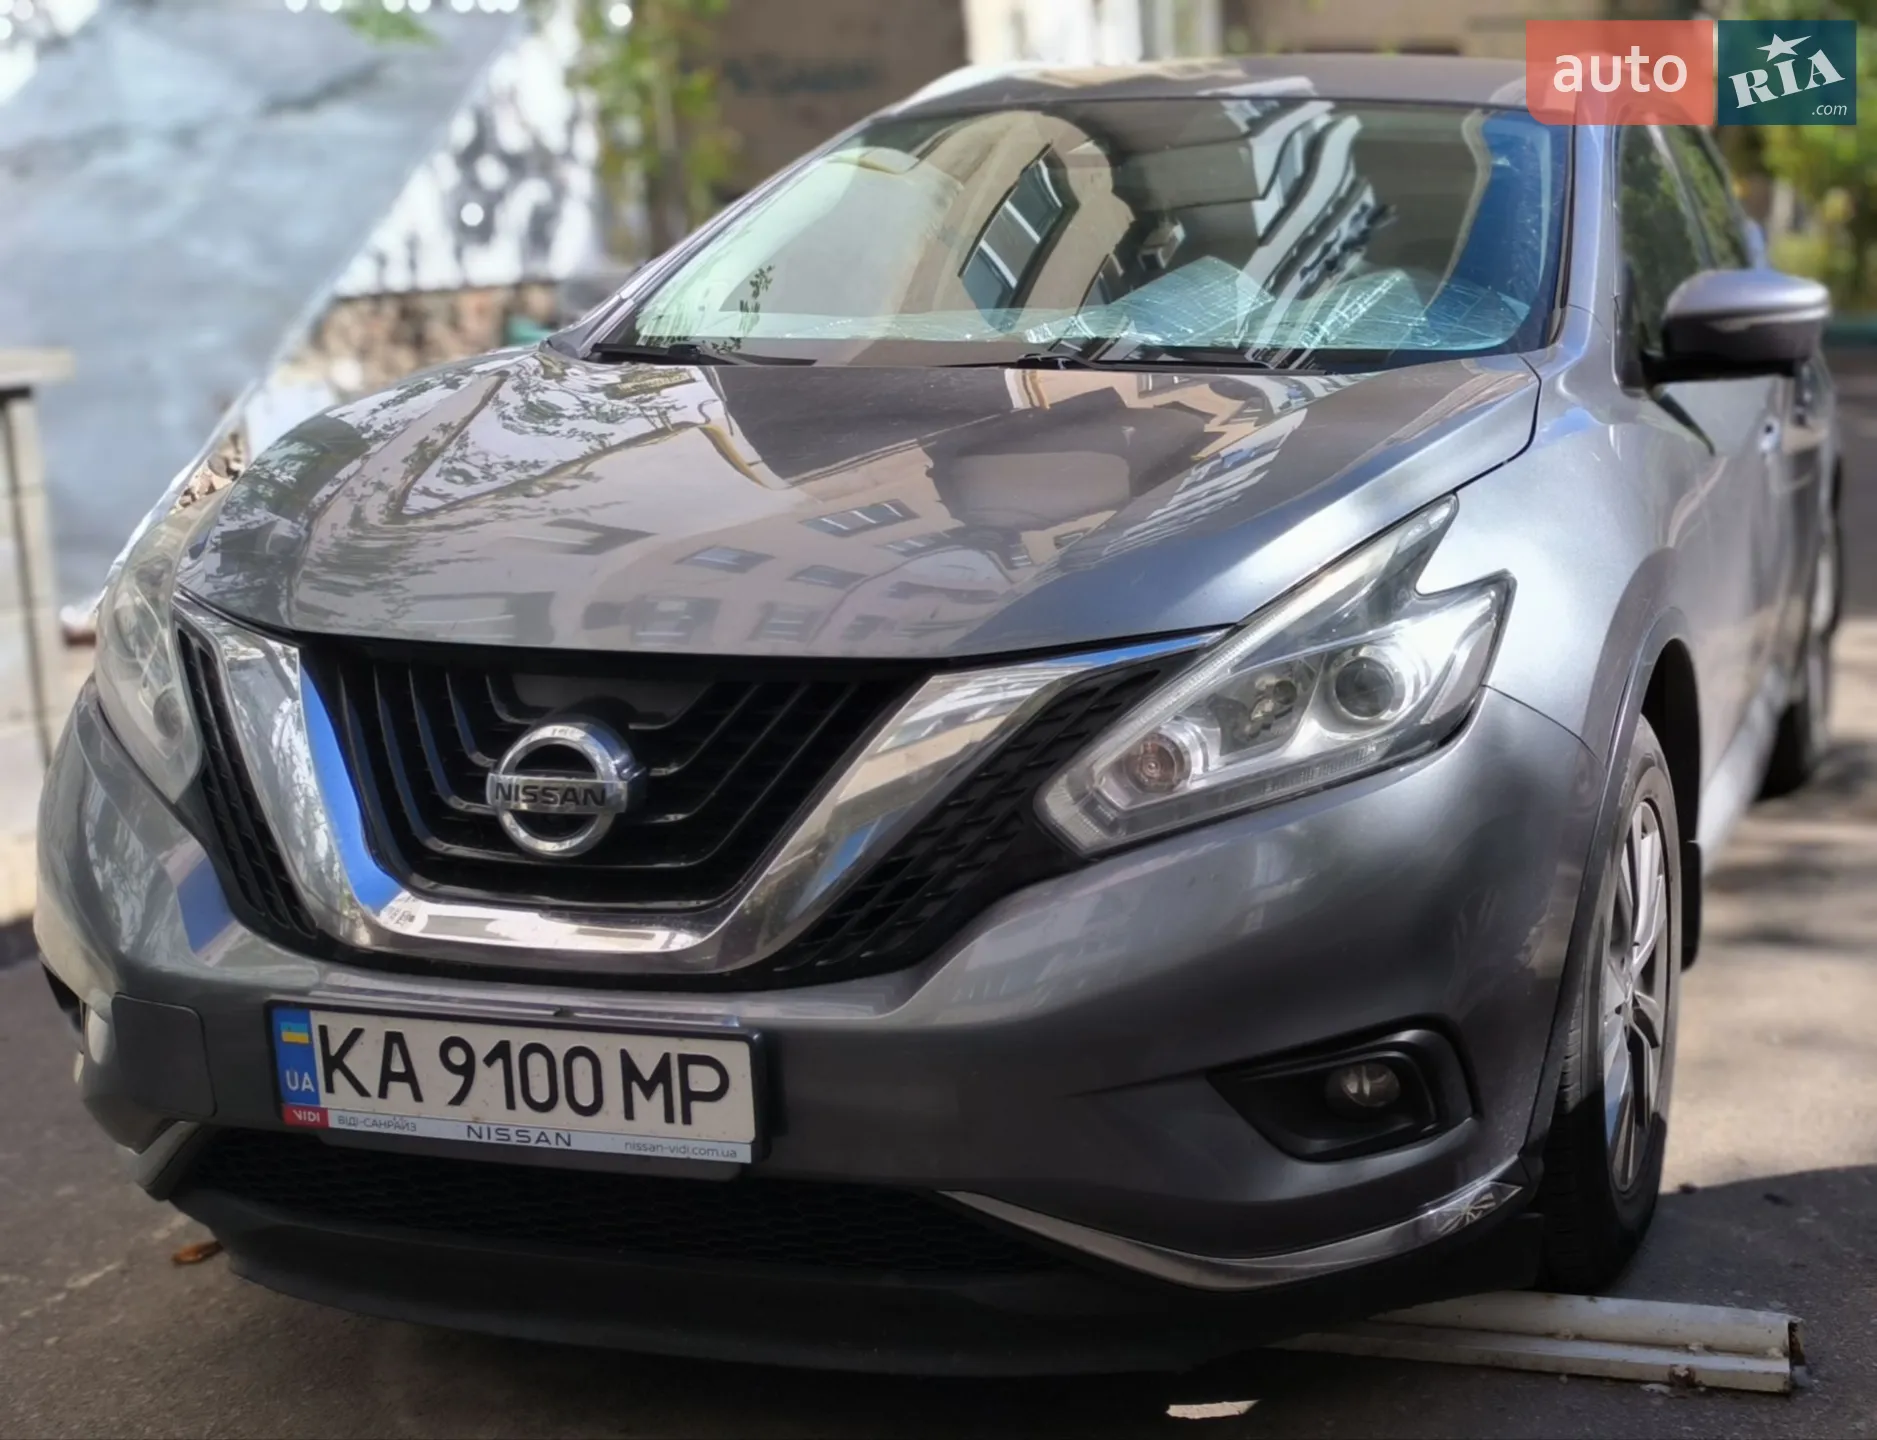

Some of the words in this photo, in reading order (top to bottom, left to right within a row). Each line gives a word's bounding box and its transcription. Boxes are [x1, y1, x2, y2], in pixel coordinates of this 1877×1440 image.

[495, 782, 606, 807] NISSAN
[286, 1069, 315, 1093] UA
[318, 1024, 424, 1103] KA
[439, 1035, 603, 1117] 9100
[620, 1048, 730, 1126] MP
[293, 1109, 321, 1123] VIDI
[466, 1124, 572, 1147] NISSAN
[624, 1141, 738, 1159] nissan-vidi.com.ua
